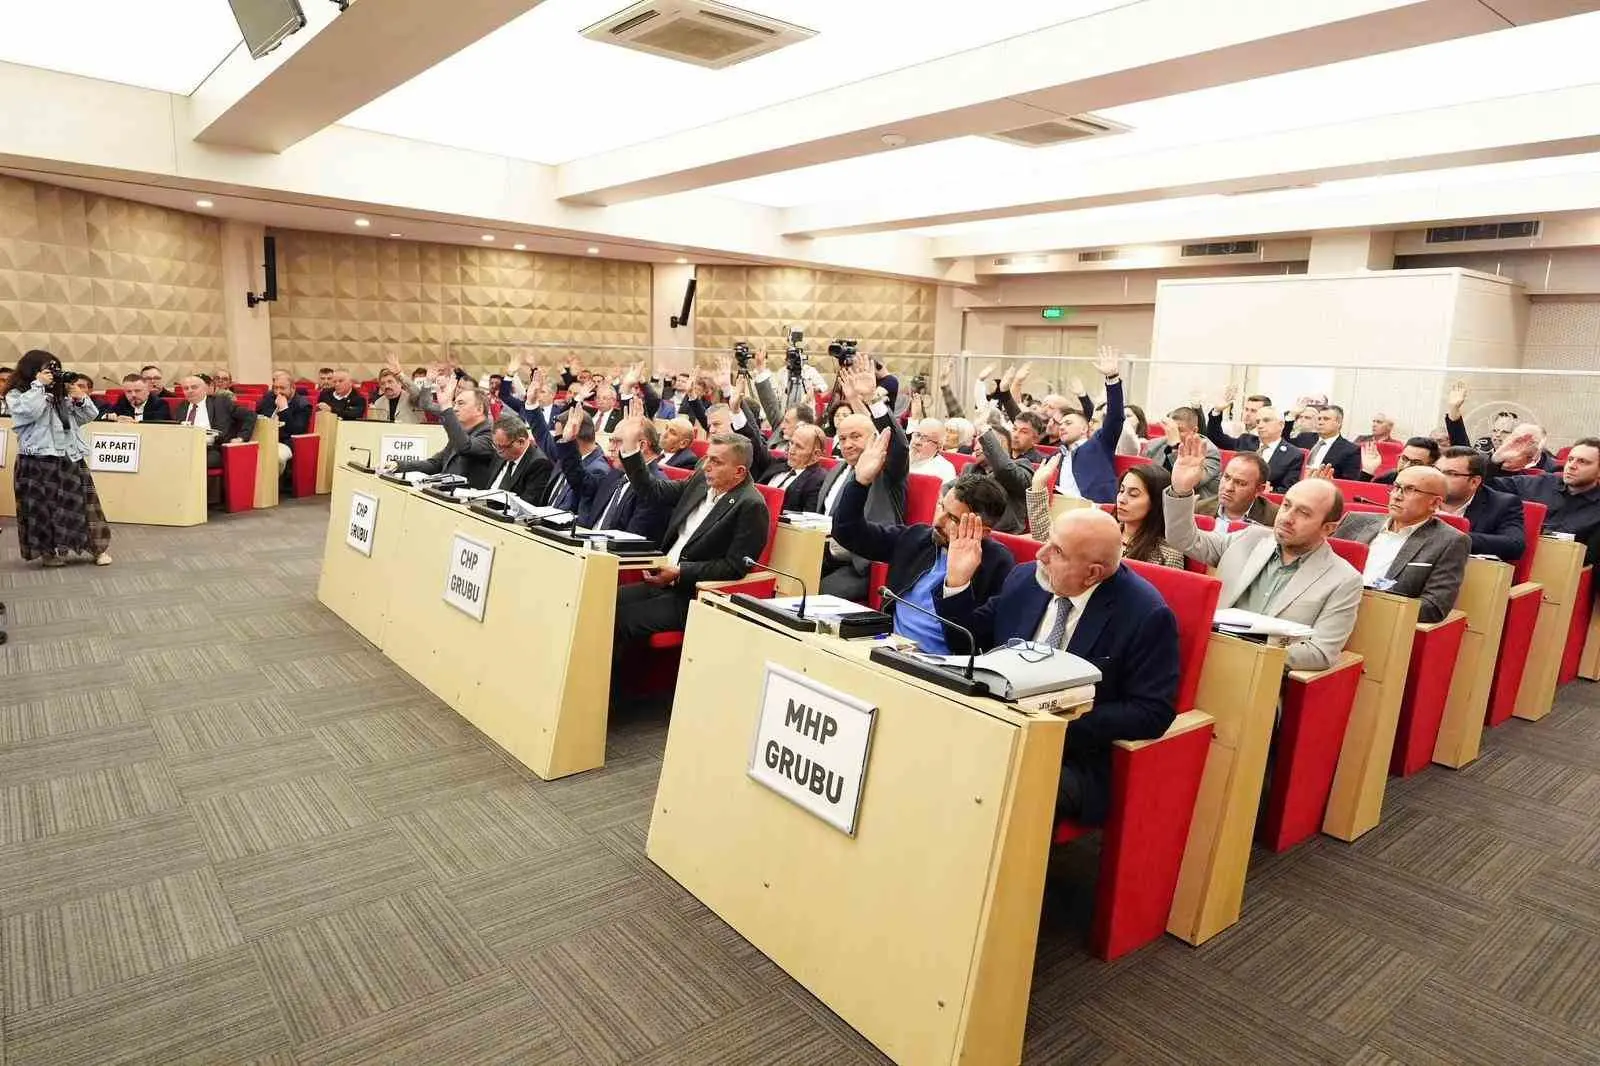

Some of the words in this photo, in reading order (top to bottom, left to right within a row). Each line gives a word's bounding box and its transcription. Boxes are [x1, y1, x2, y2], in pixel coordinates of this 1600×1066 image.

[95, 441, 107, 449] AK
[394, 441, 414, 450] CHP
[99, 454, 129, 463] GRUBU
[356, 502, 368, 517] CHP
[460, 548, 479, 569] CHP
[450, 574, 480, 603] GRUBU
[784, 698, 838, 745] MHP
[765, 740, 844, 804] GRUBU
